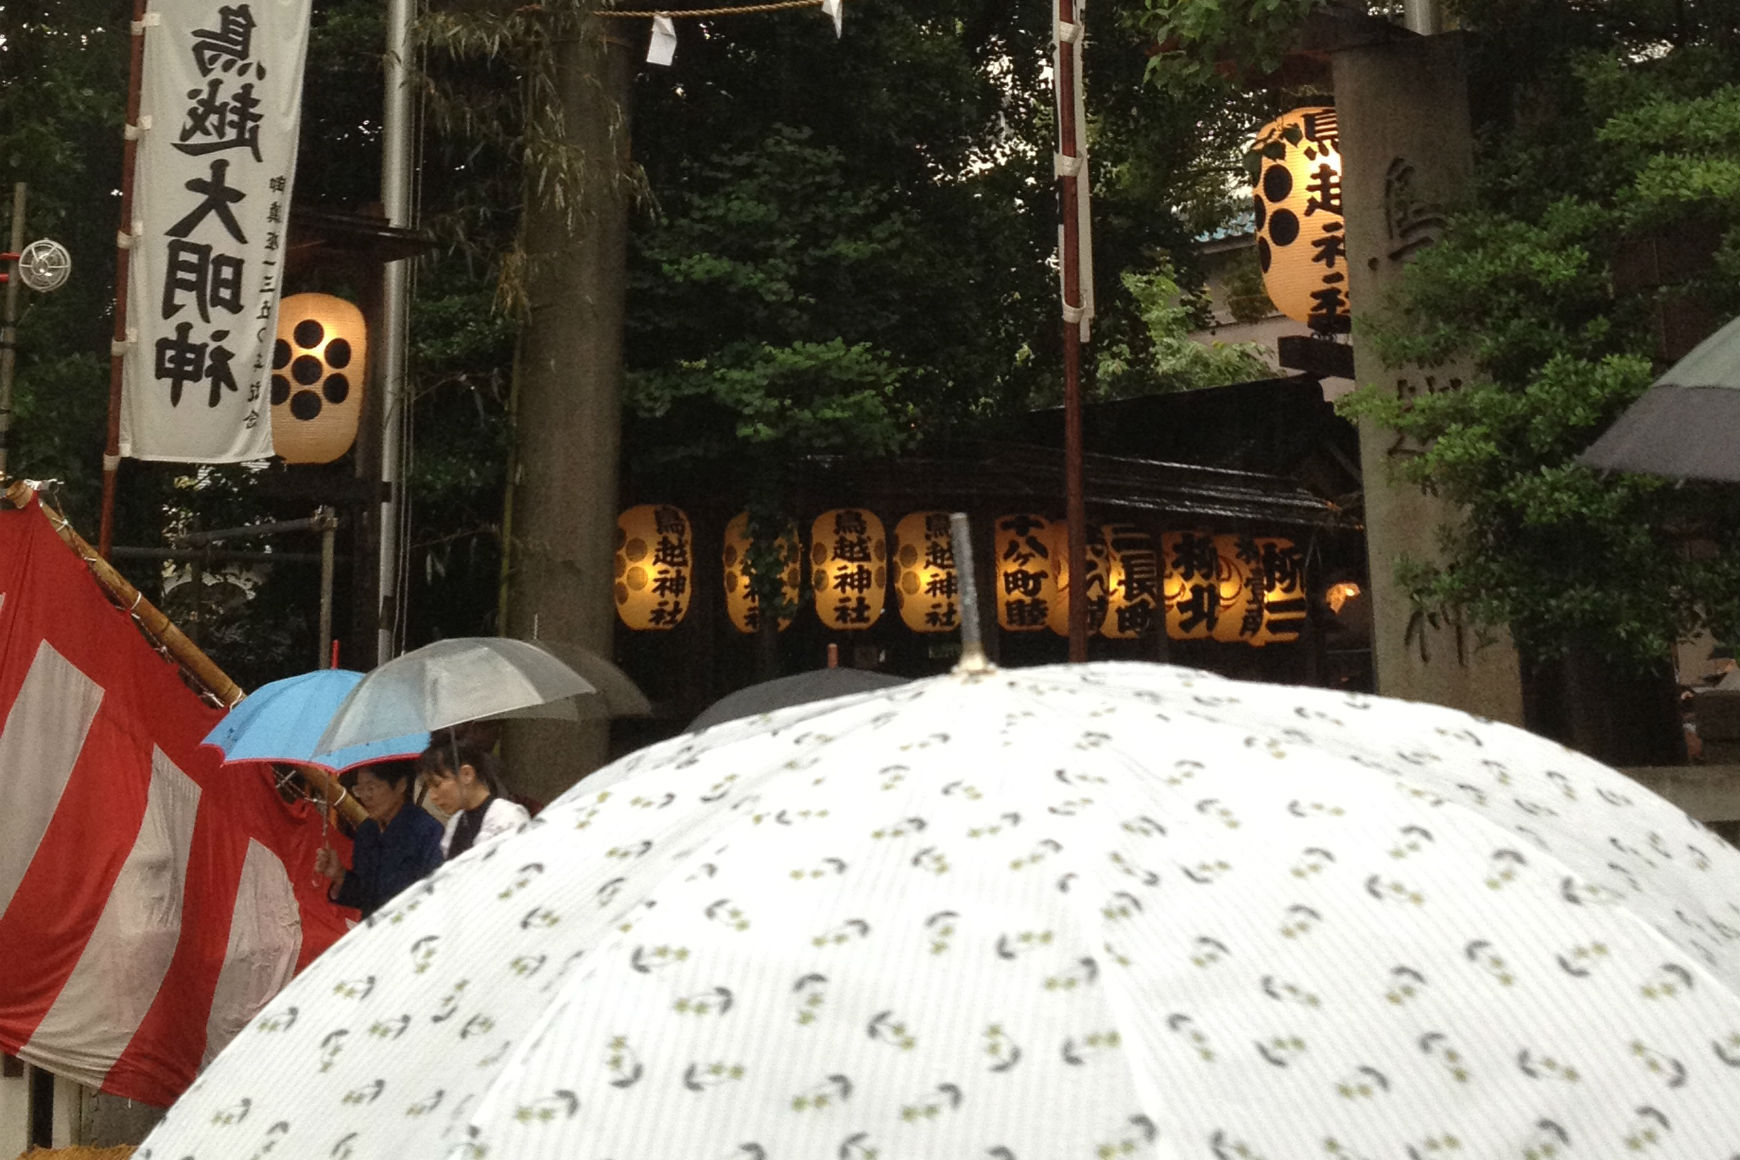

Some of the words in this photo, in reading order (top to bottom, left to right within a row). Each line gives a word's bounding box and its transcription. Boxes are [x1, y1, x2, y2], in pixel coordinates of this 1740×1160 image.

[648, 505, 688, 625] 鳥越神社
[830, 510, 872, 624] 鳥越神社
[923, 514, 959, 626] 鳥越神社
